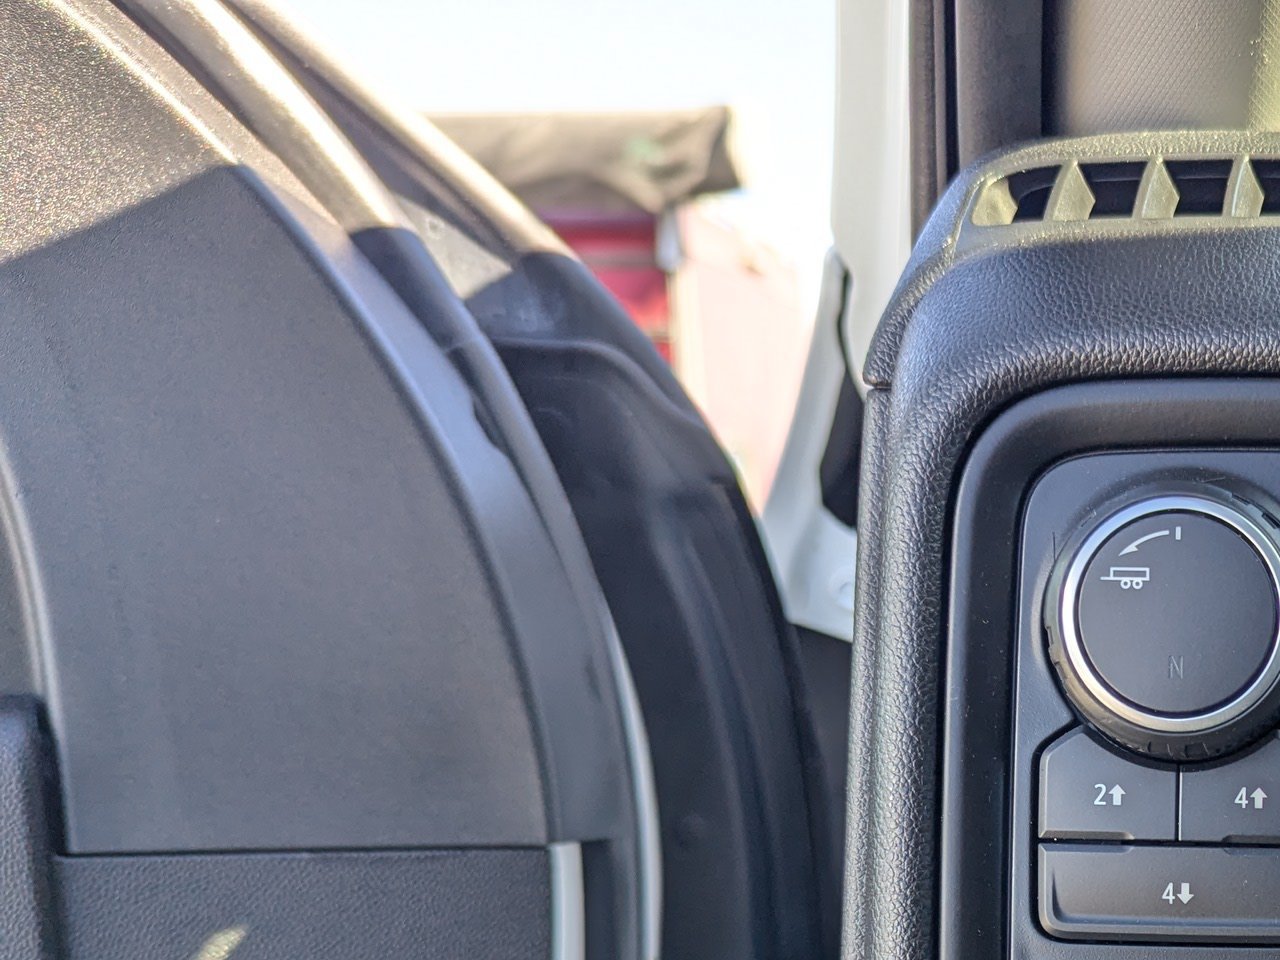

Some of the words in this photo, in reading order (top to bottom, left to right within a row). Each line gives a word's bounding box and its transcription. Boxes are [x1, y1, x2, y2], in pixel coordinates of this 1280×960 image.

[1168, 655, 1184, 679] N
[1094, 783, 1107, 806] 2
[1234, 786, 1249, 809] 4
[1161, 882, 1176, 905] 4
